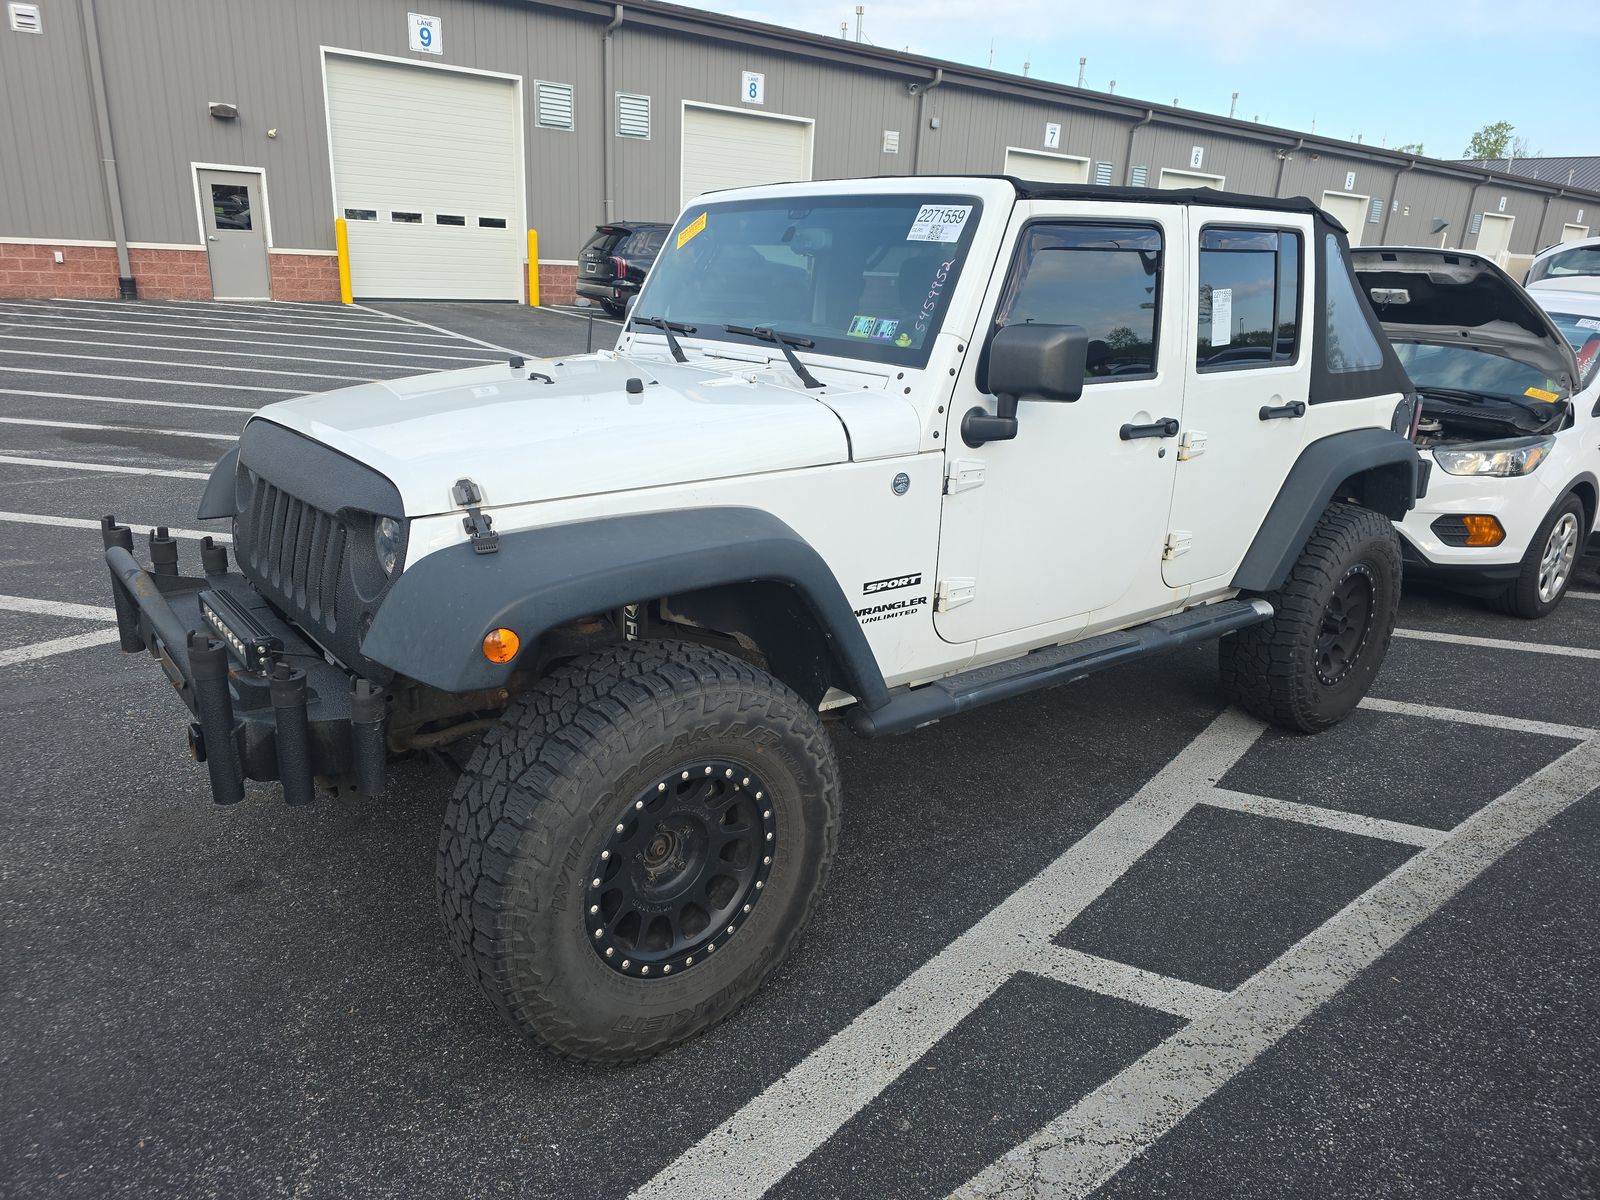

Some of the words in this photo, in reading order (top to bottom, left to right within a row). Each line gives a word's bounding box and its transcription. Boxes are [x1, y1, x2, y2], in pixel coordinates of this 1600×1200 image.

[420, 27, 432, 47] 9
[749, 82, 757, 98] 8
[1050, 131, 1056, 144] 7
[1194, 153, 1200, 165] 6
[916, 208, 966, 224] 2271559
[915, 258, 956, 332] 5459952
[866, 576, 921, 591] SPORT
[861, 609, 918, 624] UNLIMITED
